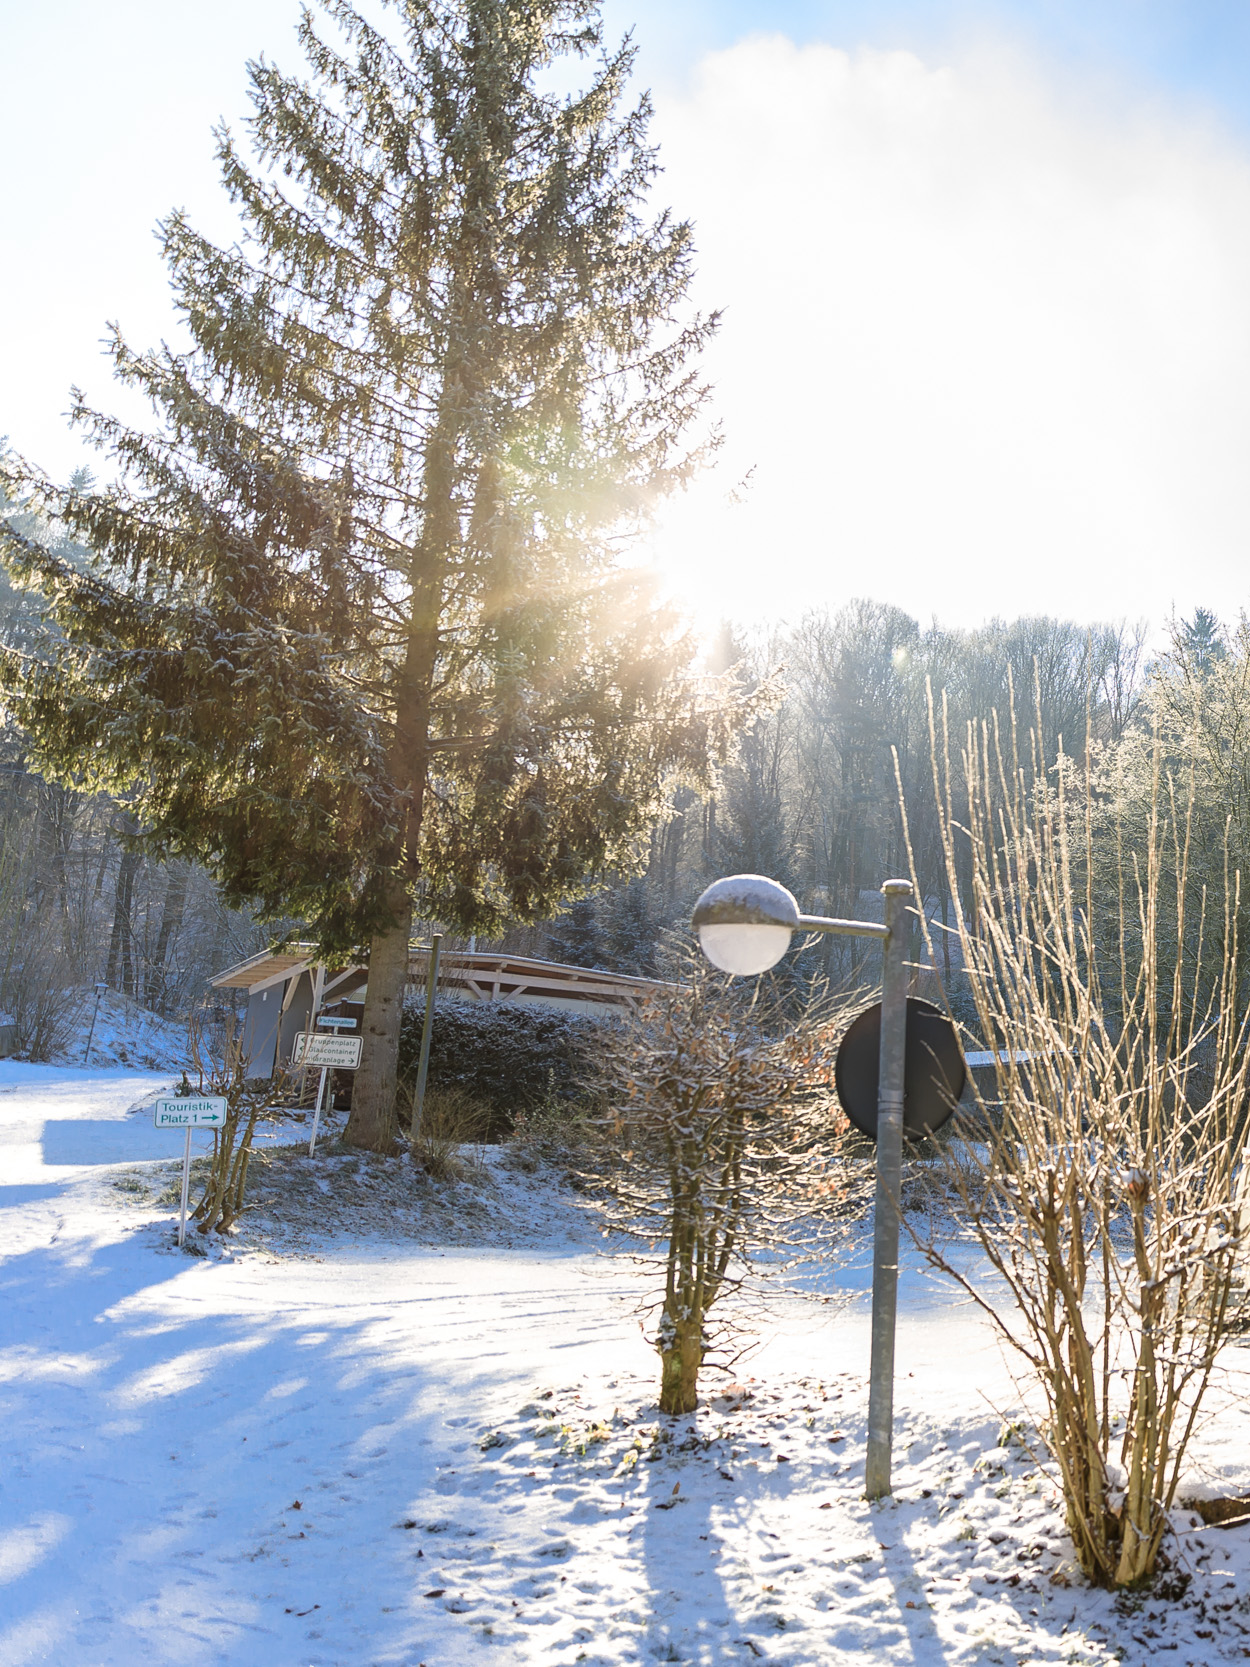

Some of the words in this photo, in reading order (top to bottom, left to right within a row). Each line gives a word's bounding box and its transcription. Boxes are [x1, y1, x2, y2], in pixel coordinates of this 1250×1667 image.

[162, 1102, 218, 1112] Touristik-
[161, 1114, 189, 1123] Platz
[193, 1114, 198, 1123] 1
